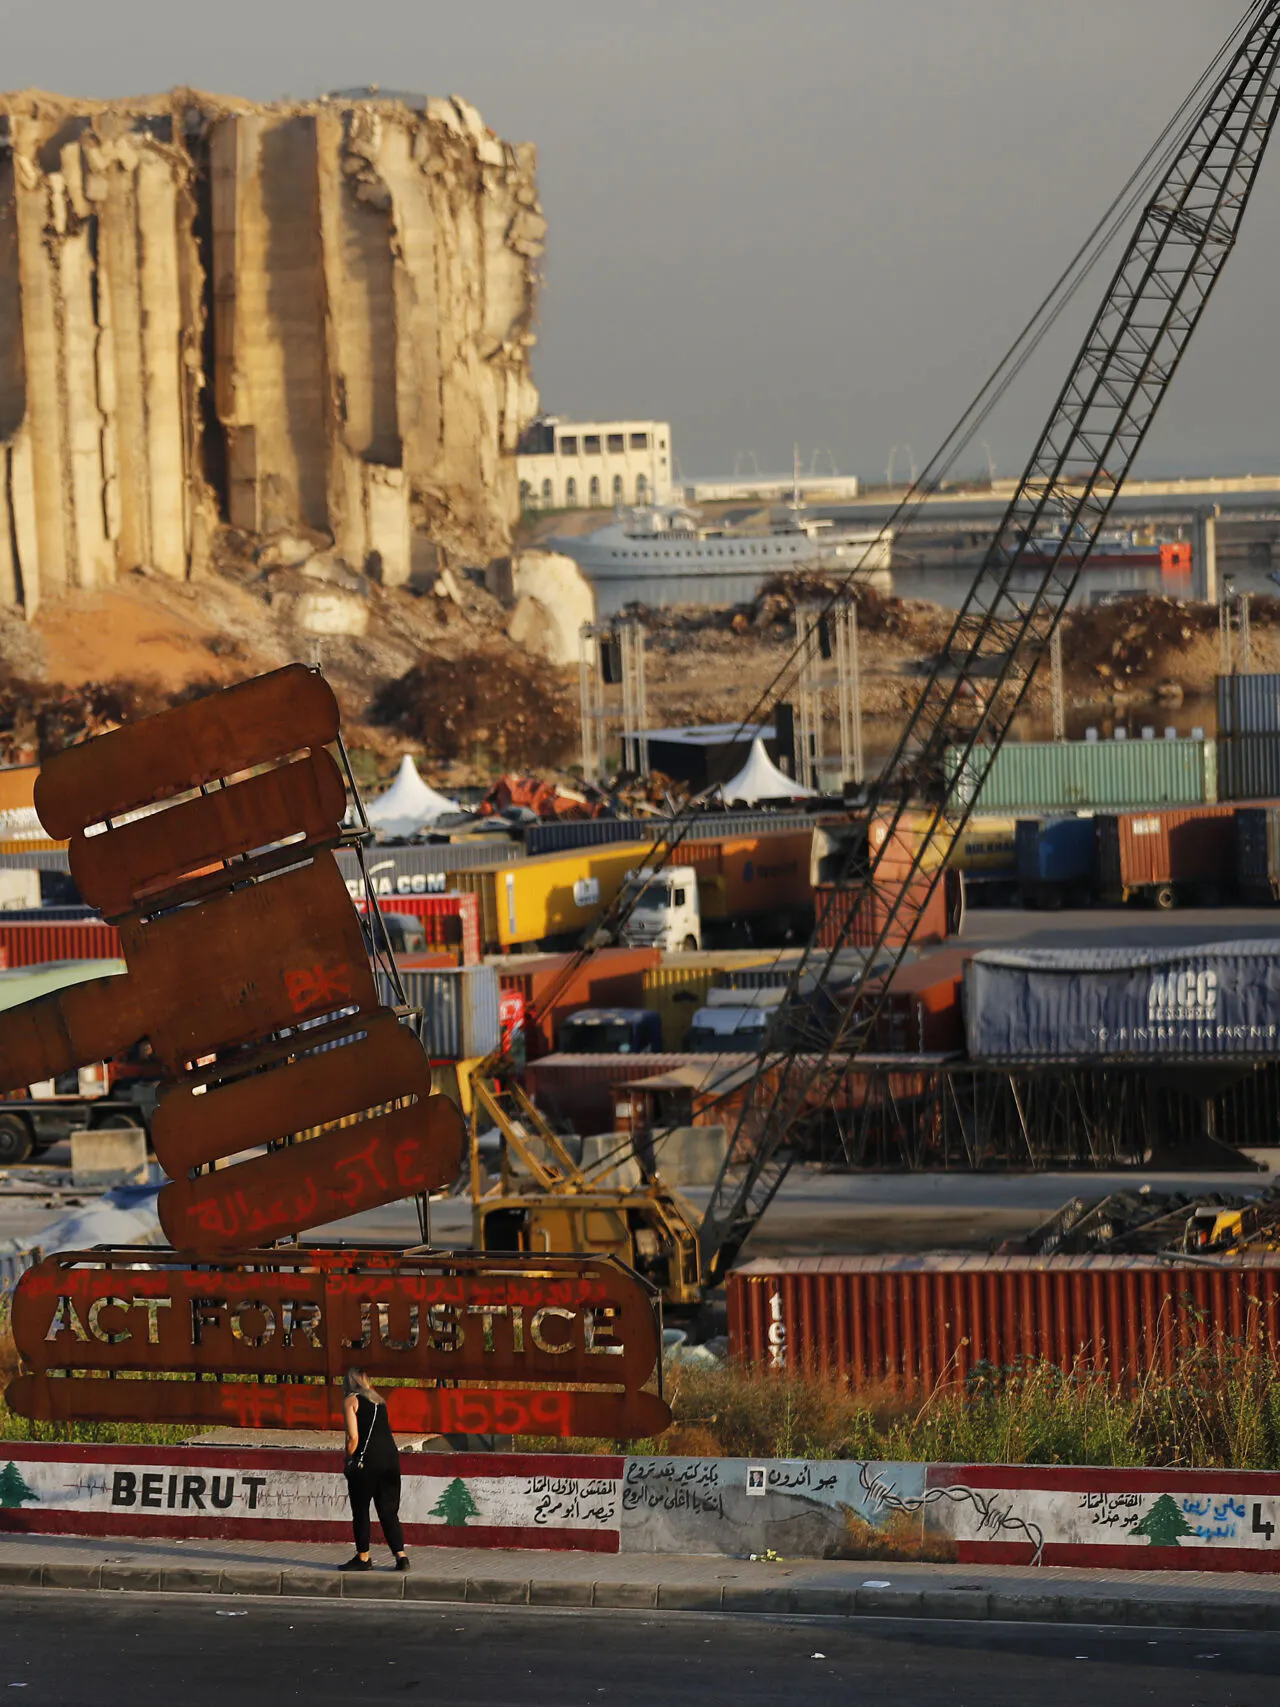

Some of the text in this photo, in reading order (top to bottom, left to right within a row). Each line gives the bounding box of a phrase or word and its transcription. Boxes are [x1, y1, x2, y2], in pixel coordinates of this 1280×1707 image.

[397, 872, 447, 894] CGM
[1148, 969, 1218, 1007] MCC
[1090, 1025, 1128, 1041] YOR
[44, 1296, 625, 1357] ACT FOR JUSTICE
[111, 1471, 267, 1510] BEIRUT
[1251, 1502, 1276, 1542] 4
